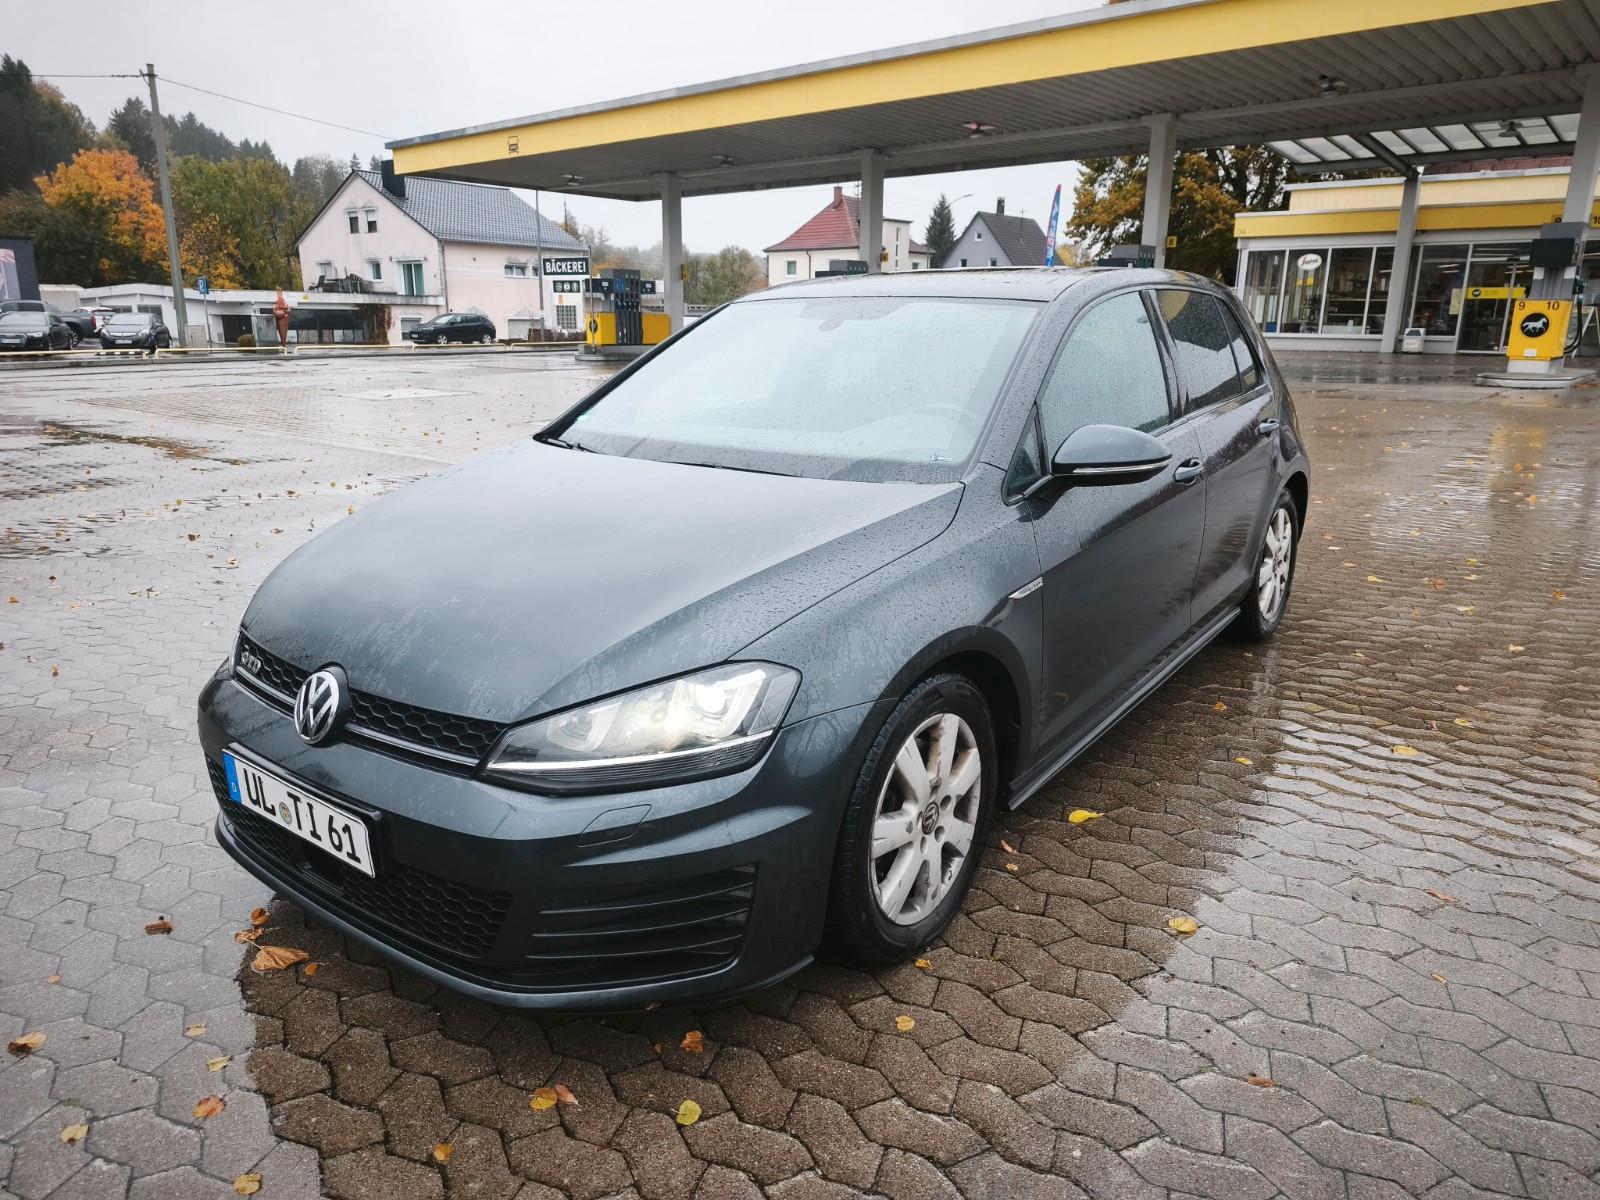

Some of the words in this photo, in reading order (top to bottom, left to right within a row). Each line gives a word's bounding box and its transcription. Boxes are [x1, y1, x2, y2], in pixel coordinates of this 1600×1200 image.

[545, 259, 586, 272] BÄCKEREI
[1518, 301, 1526, 310] 9
[1546, 301, 1560, 310] 10
[231, 782, 237, 792] D
[243, 767, 276, 816] UL
[287, 791, 322, 842] TI
[328, 814, 361, 864] 61
